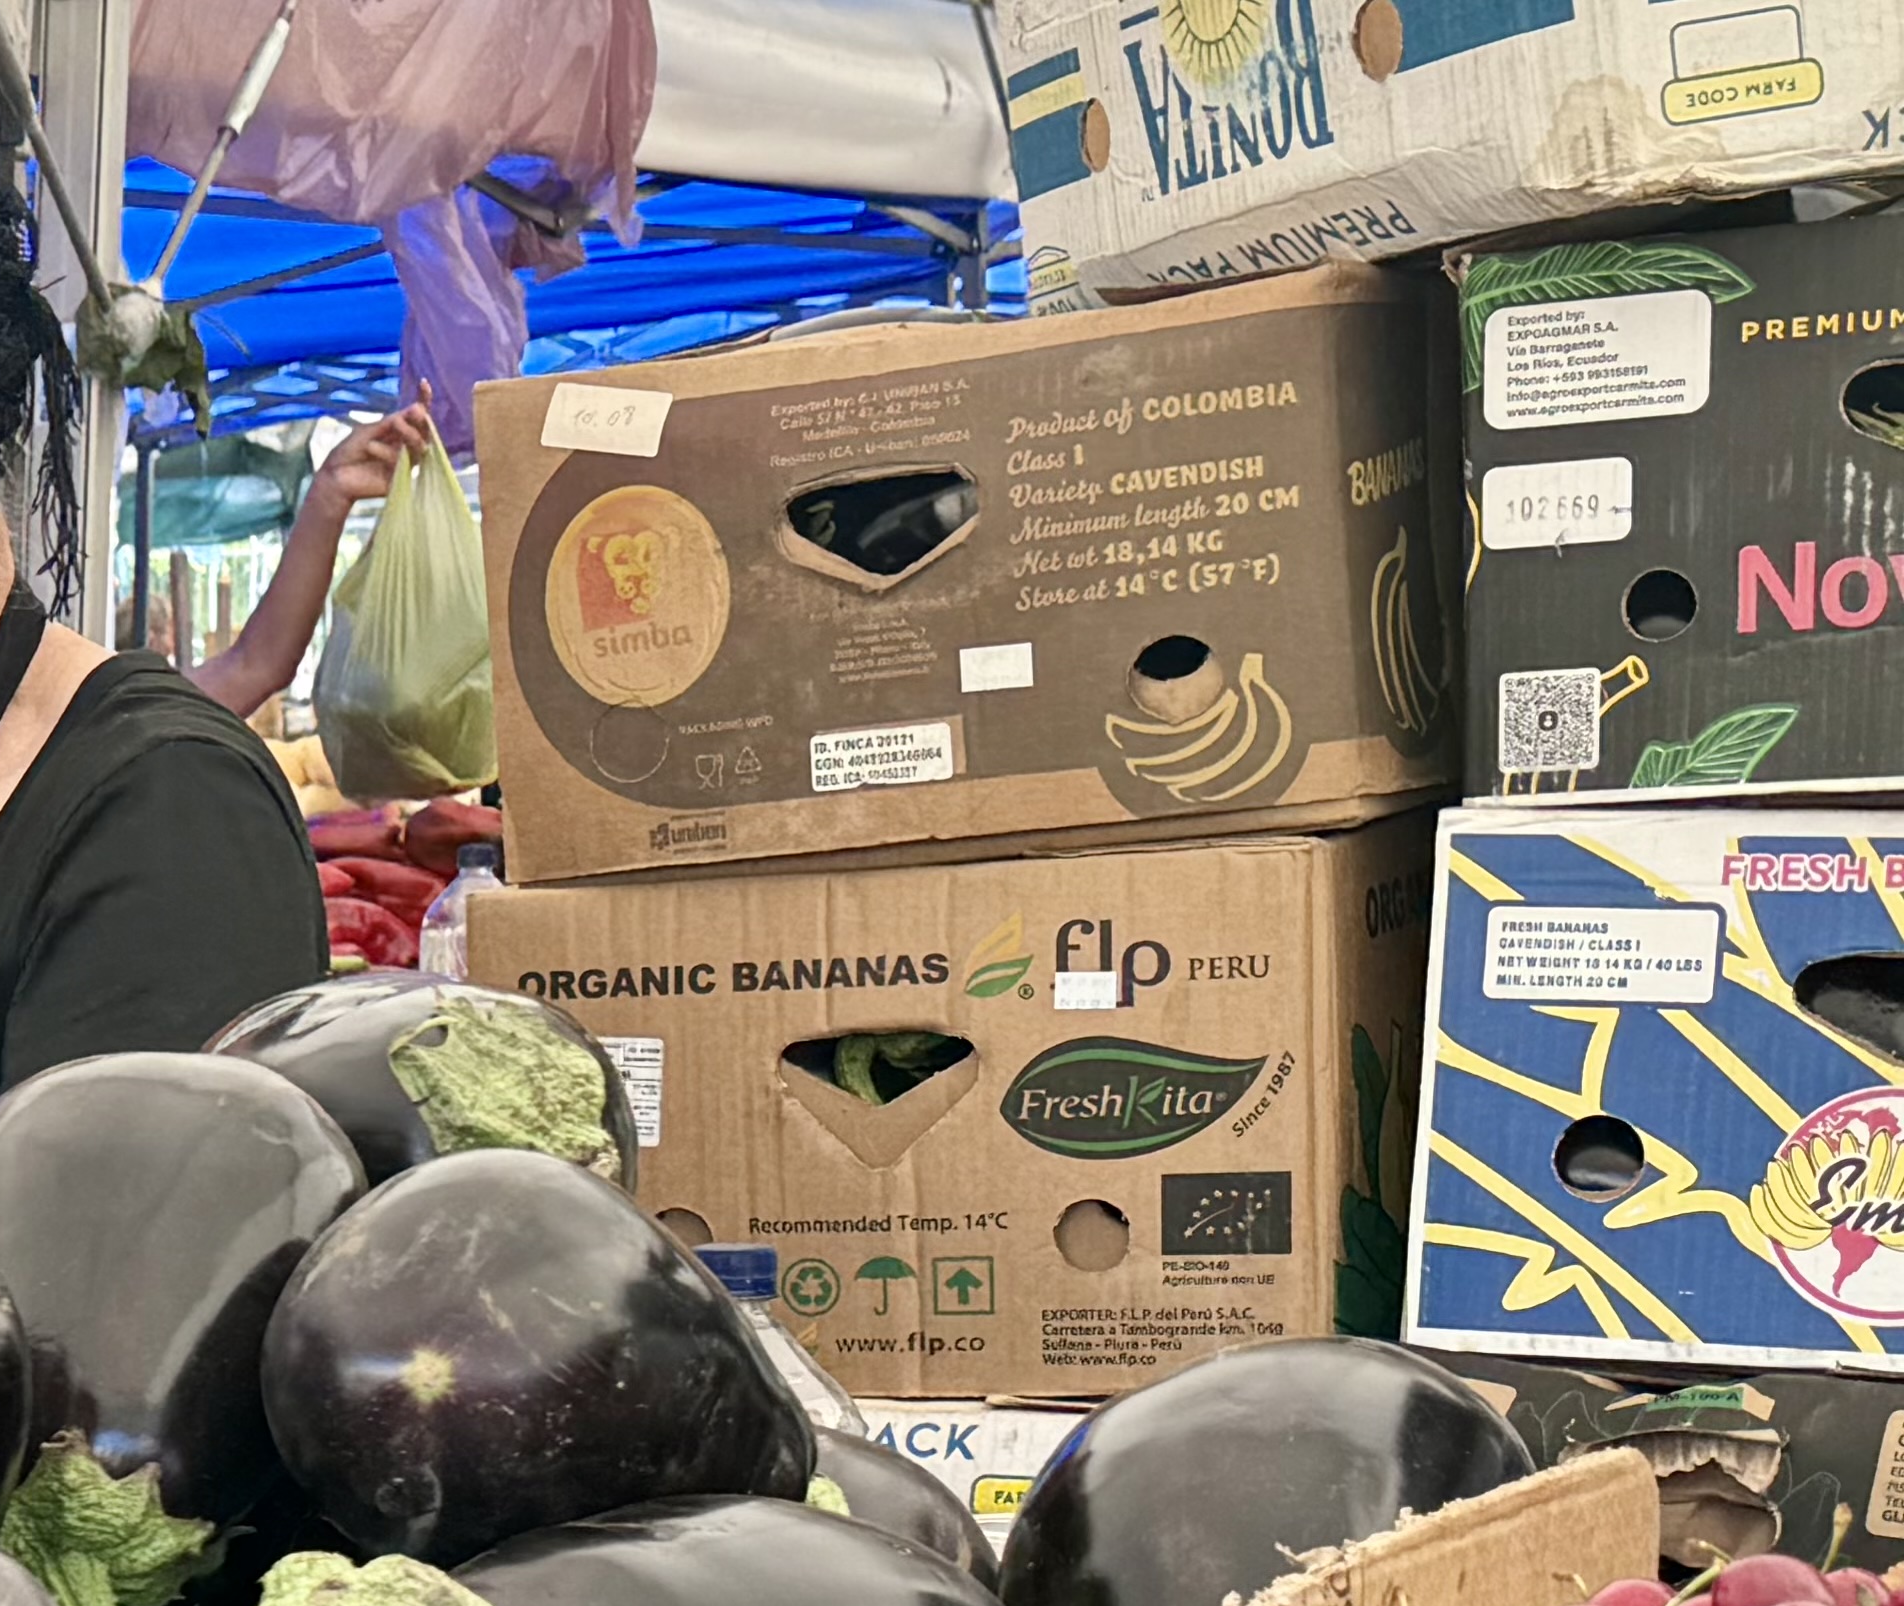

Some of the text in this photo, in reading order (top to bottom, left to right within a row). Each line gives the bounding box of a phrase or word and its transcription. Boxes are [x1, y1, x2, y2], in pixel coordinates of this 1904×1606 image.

[1124, 0, 1334, 196] BONITA
[1685, 77, 1797, 108] FARM CODE
[1236, 200, 1419, 272] PREMIUM
[1507, 309, 1585, 328] Exported by:
[1593, 321, 1619, 334] S.A.
[1741, 308, 1904, 343] PREMIUM
[1506, 359, 1529, 373] Los
[1567, 350, 1620, 368] Ecuador
[1506, 374, 1550, 388] Phone:
[1004, 410, 1100, 444] Product
[1103, 396, 1135, 436] of
[1141, 380, 1299, 423] COLOMBIA
[1005, 449, 1067, 476] Class
[1007, 454, 1265, 509] Variety CAVENDISH
[1009, 484, 1301, 545] Minimum length 20 CM
[1012, 528, 1224, 580] Net wt 18,14 KG
[1014, 584, 1081, 613] Store
[1082, 577, 1112, 602] at
[594, 622, 692, 659] simba
[1720, 853, 1869, 893] FRESH
[1500, 920, 1609, 935] FRESH BANANAS
[1498, 936, 1576, 951] CAVENDISH
[1587, 938, 1633, 952] CLASS
[518, 952, 950, 1001] ORGANIC BANANAS
[1187, 954, 1271, 981] PERU
[1497, 955, 1525, 969] NET
[1526, 955, 1581, 970] WEIGHT
[1676, 959, 1704, 972] LBS
[1529, 974, 1583, 988] LENGTH
[1606, 975, 1629, 989] CM
[1231, 1050, 1297, 1139] Since 1987
[748, 1211, 1010, 1235] Recommended Temp. 14°C
[1256, 1273, 1276, 1286] UE
[1041, 1308, 1118, 1322] EXPORTER:
[1155, 1307, 1179, 1321] del
[1215, 1306, 1256, 1320] S.A.C.
[835, 1331, 986, 1356] www.flp.co
[1041, 1324, 1106, 1337] Carretera
[1108, 1327, 1116, 1336] a
[1120, 1323, 1217, 1339] Tambogrande
[1104, 1339, 1139, 1351] Piura
[1042, 1353, 1157, 1368] Web: www.flp.co
